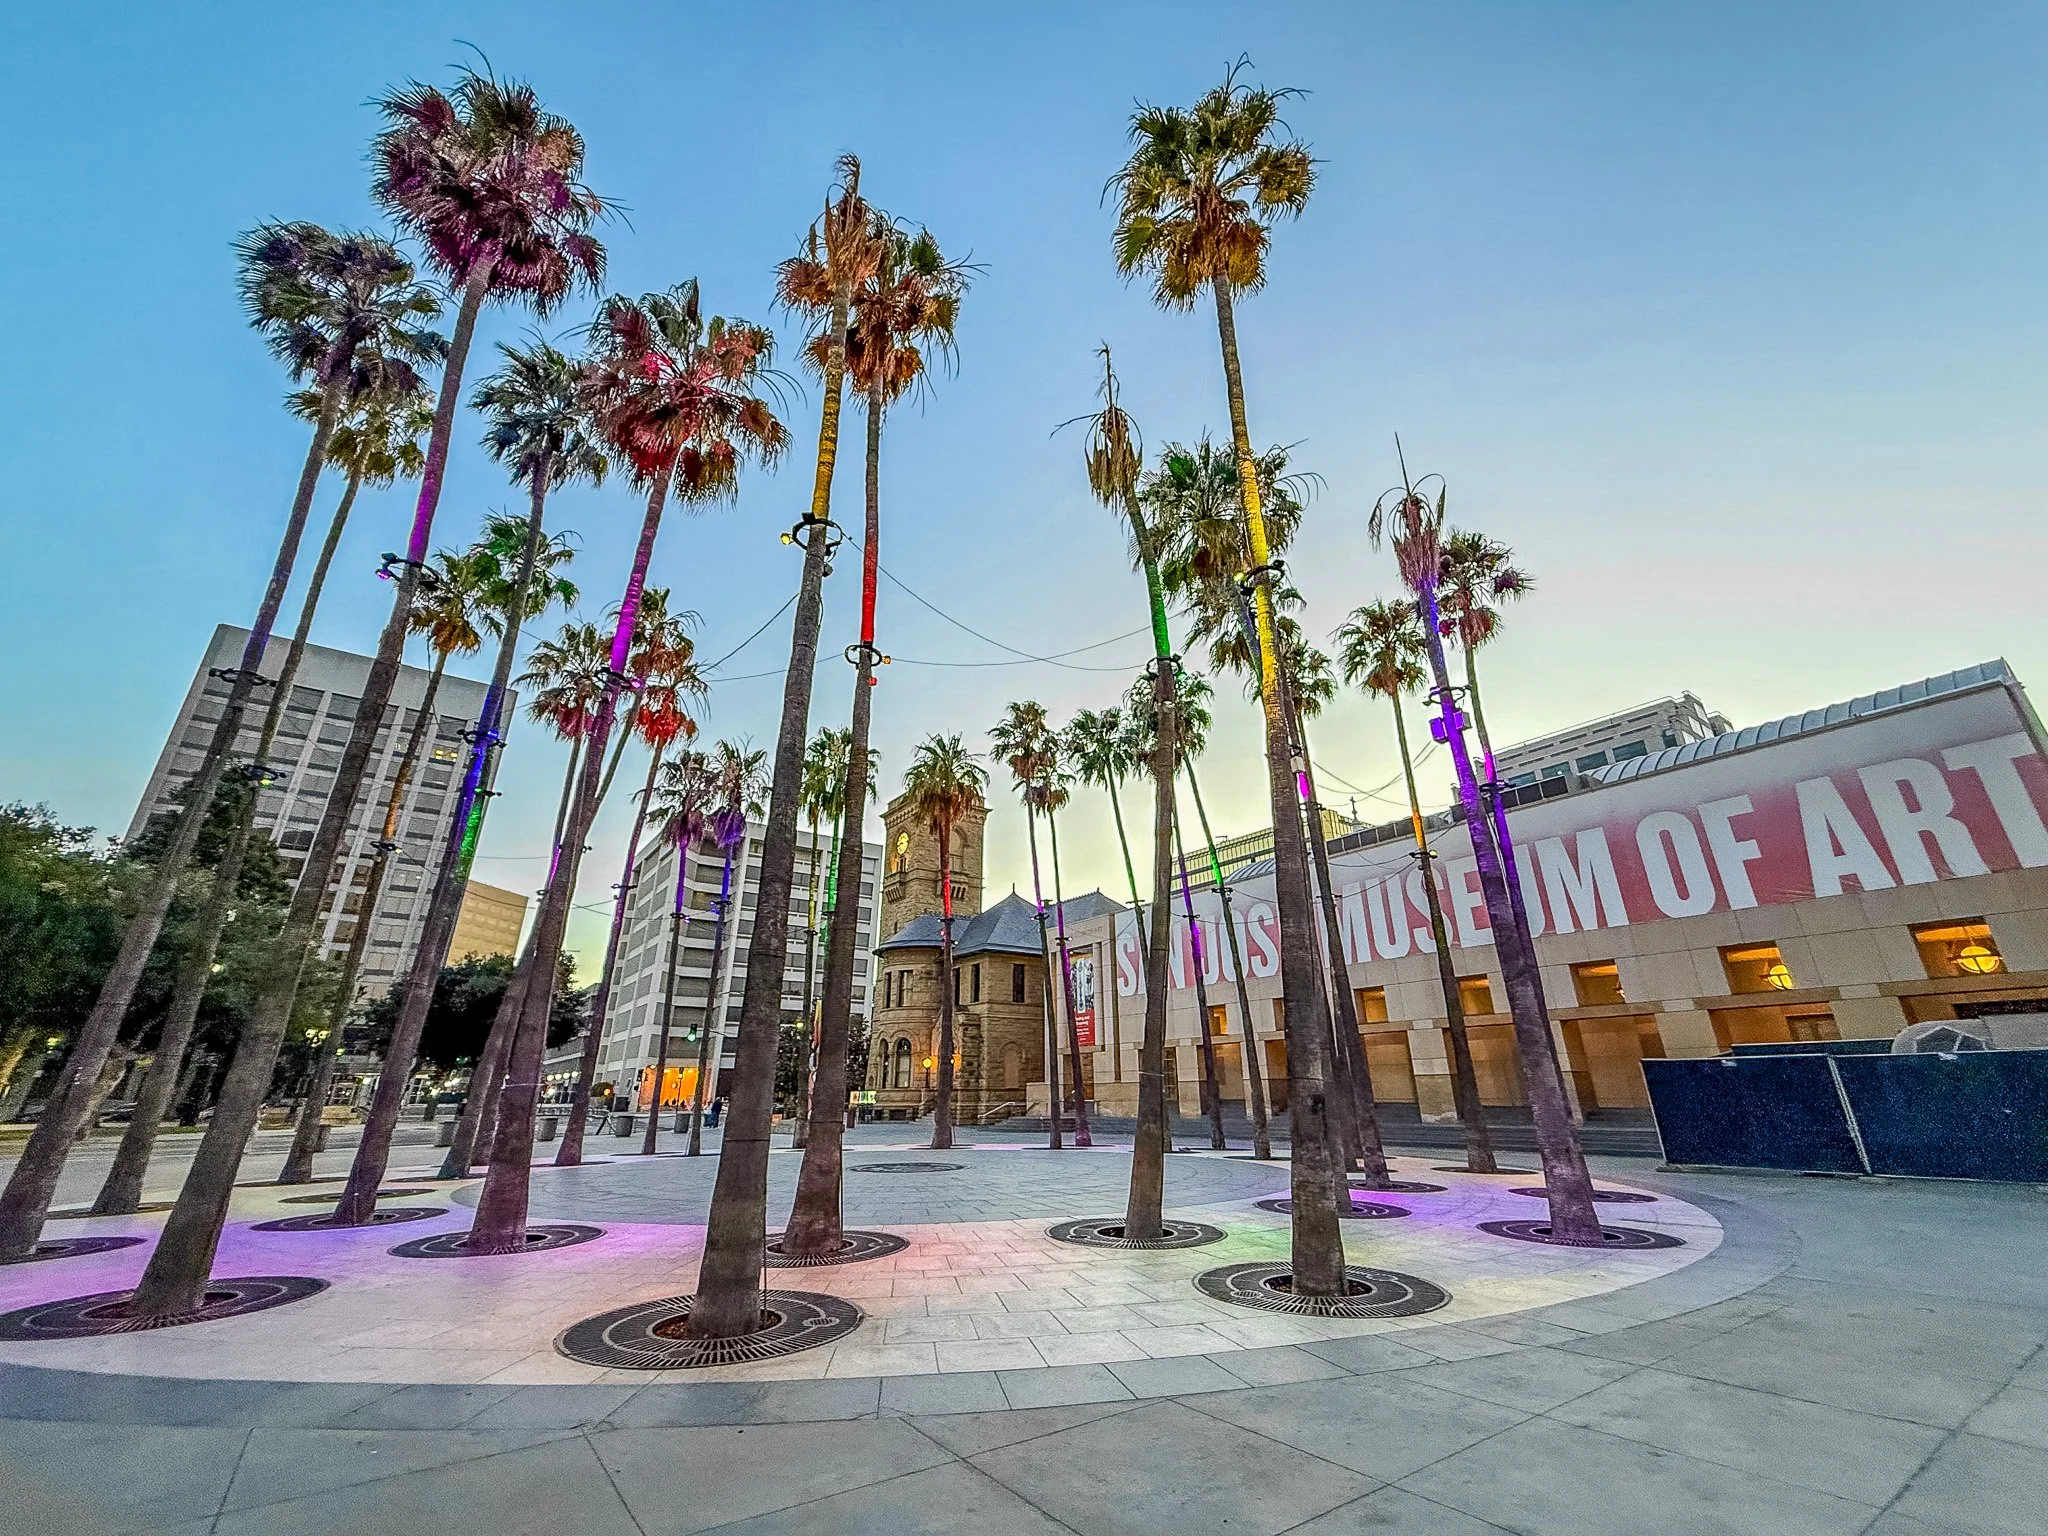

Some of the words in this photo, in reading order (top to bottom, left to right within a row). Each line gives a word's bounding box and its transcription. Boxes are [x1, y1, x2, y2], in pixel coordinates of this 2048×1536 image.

[1116, 920, 1186, 997] SN
[1200, 902, 1280, 985] JOS
[1635, 794, 1763, 919] OF
[1796, 731, 2048, 898] ART
